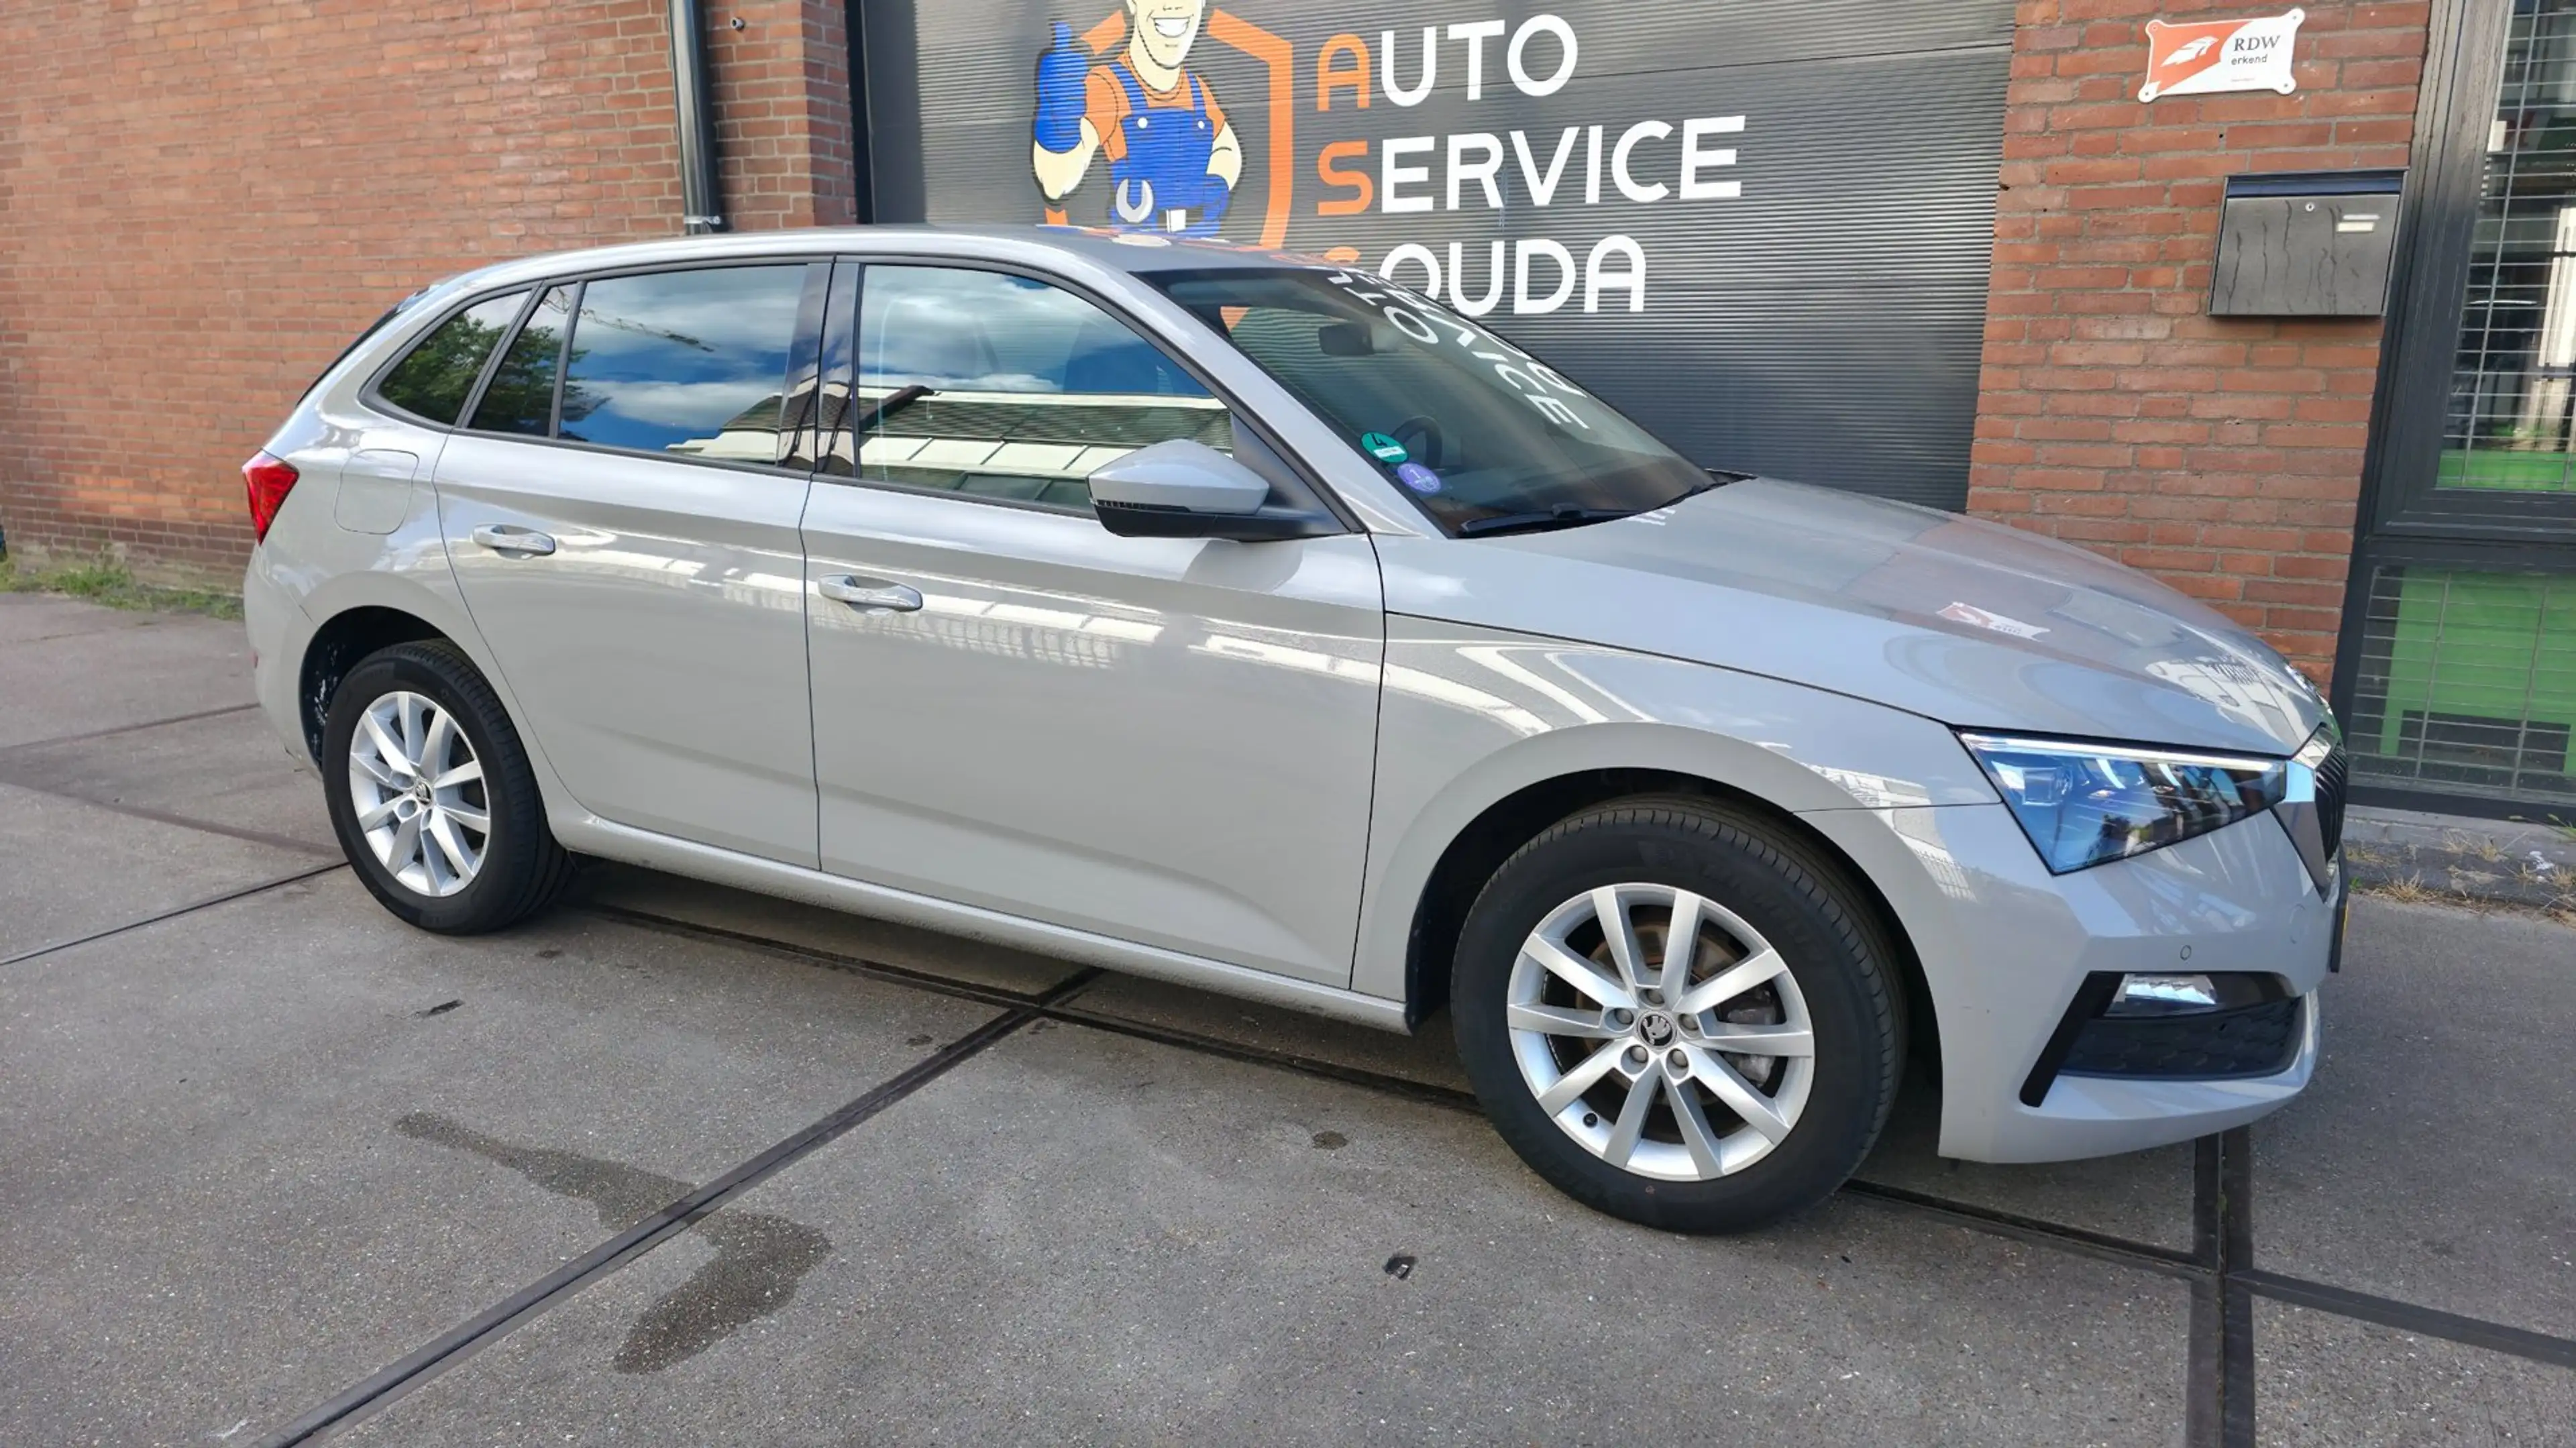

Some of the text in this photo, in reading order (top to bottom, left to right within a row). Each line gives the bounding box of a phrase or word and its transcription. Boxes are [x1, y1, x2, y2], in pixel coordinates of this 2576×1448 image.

[1318, 14, 1578, 111] AUTO
[2231, 54, 2268, 66] erkend
[2234, 36, 2280, 52] RDW
[1318, 115, 1746, 216] SERVICE
[1324, 234, 1647, 316] OUDA
